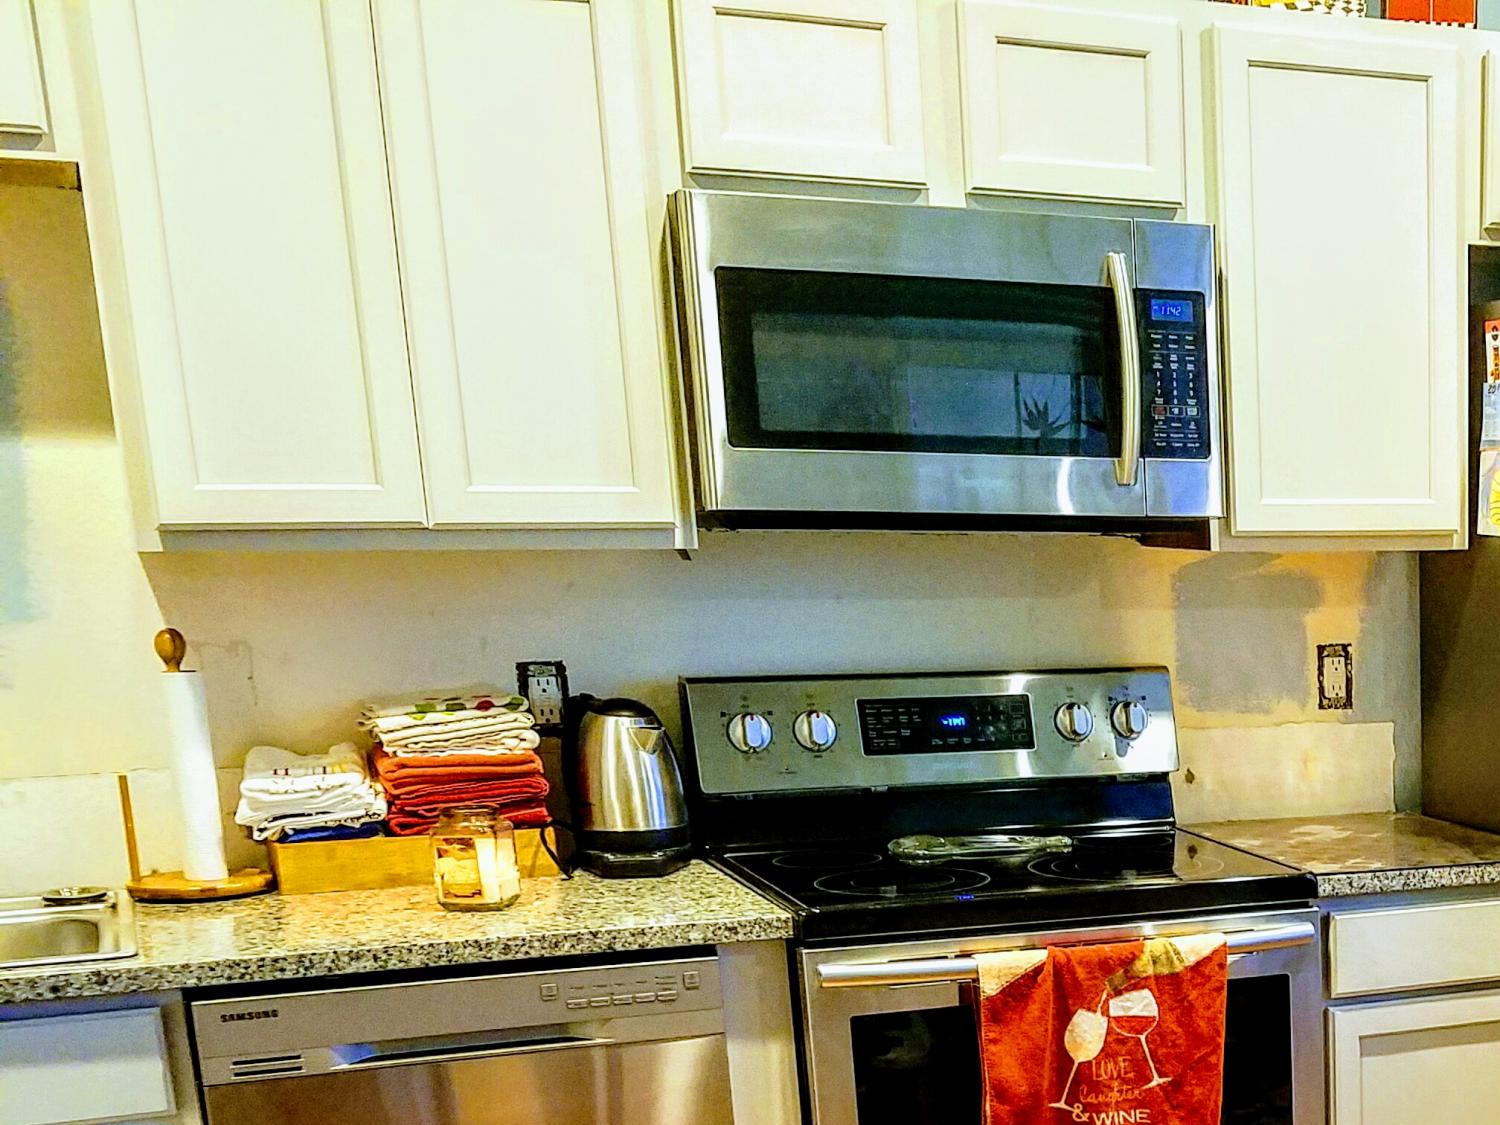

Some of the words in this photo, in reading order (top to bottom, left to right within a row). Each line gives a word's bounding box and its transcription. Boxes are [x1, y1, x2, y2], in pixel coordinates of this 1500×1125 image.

[220, 1009, 279, 1023] SAMSUNG
[1092, 1056, 1136, 1081] LOVE
[1072, 1103, 1091, 1122] &
